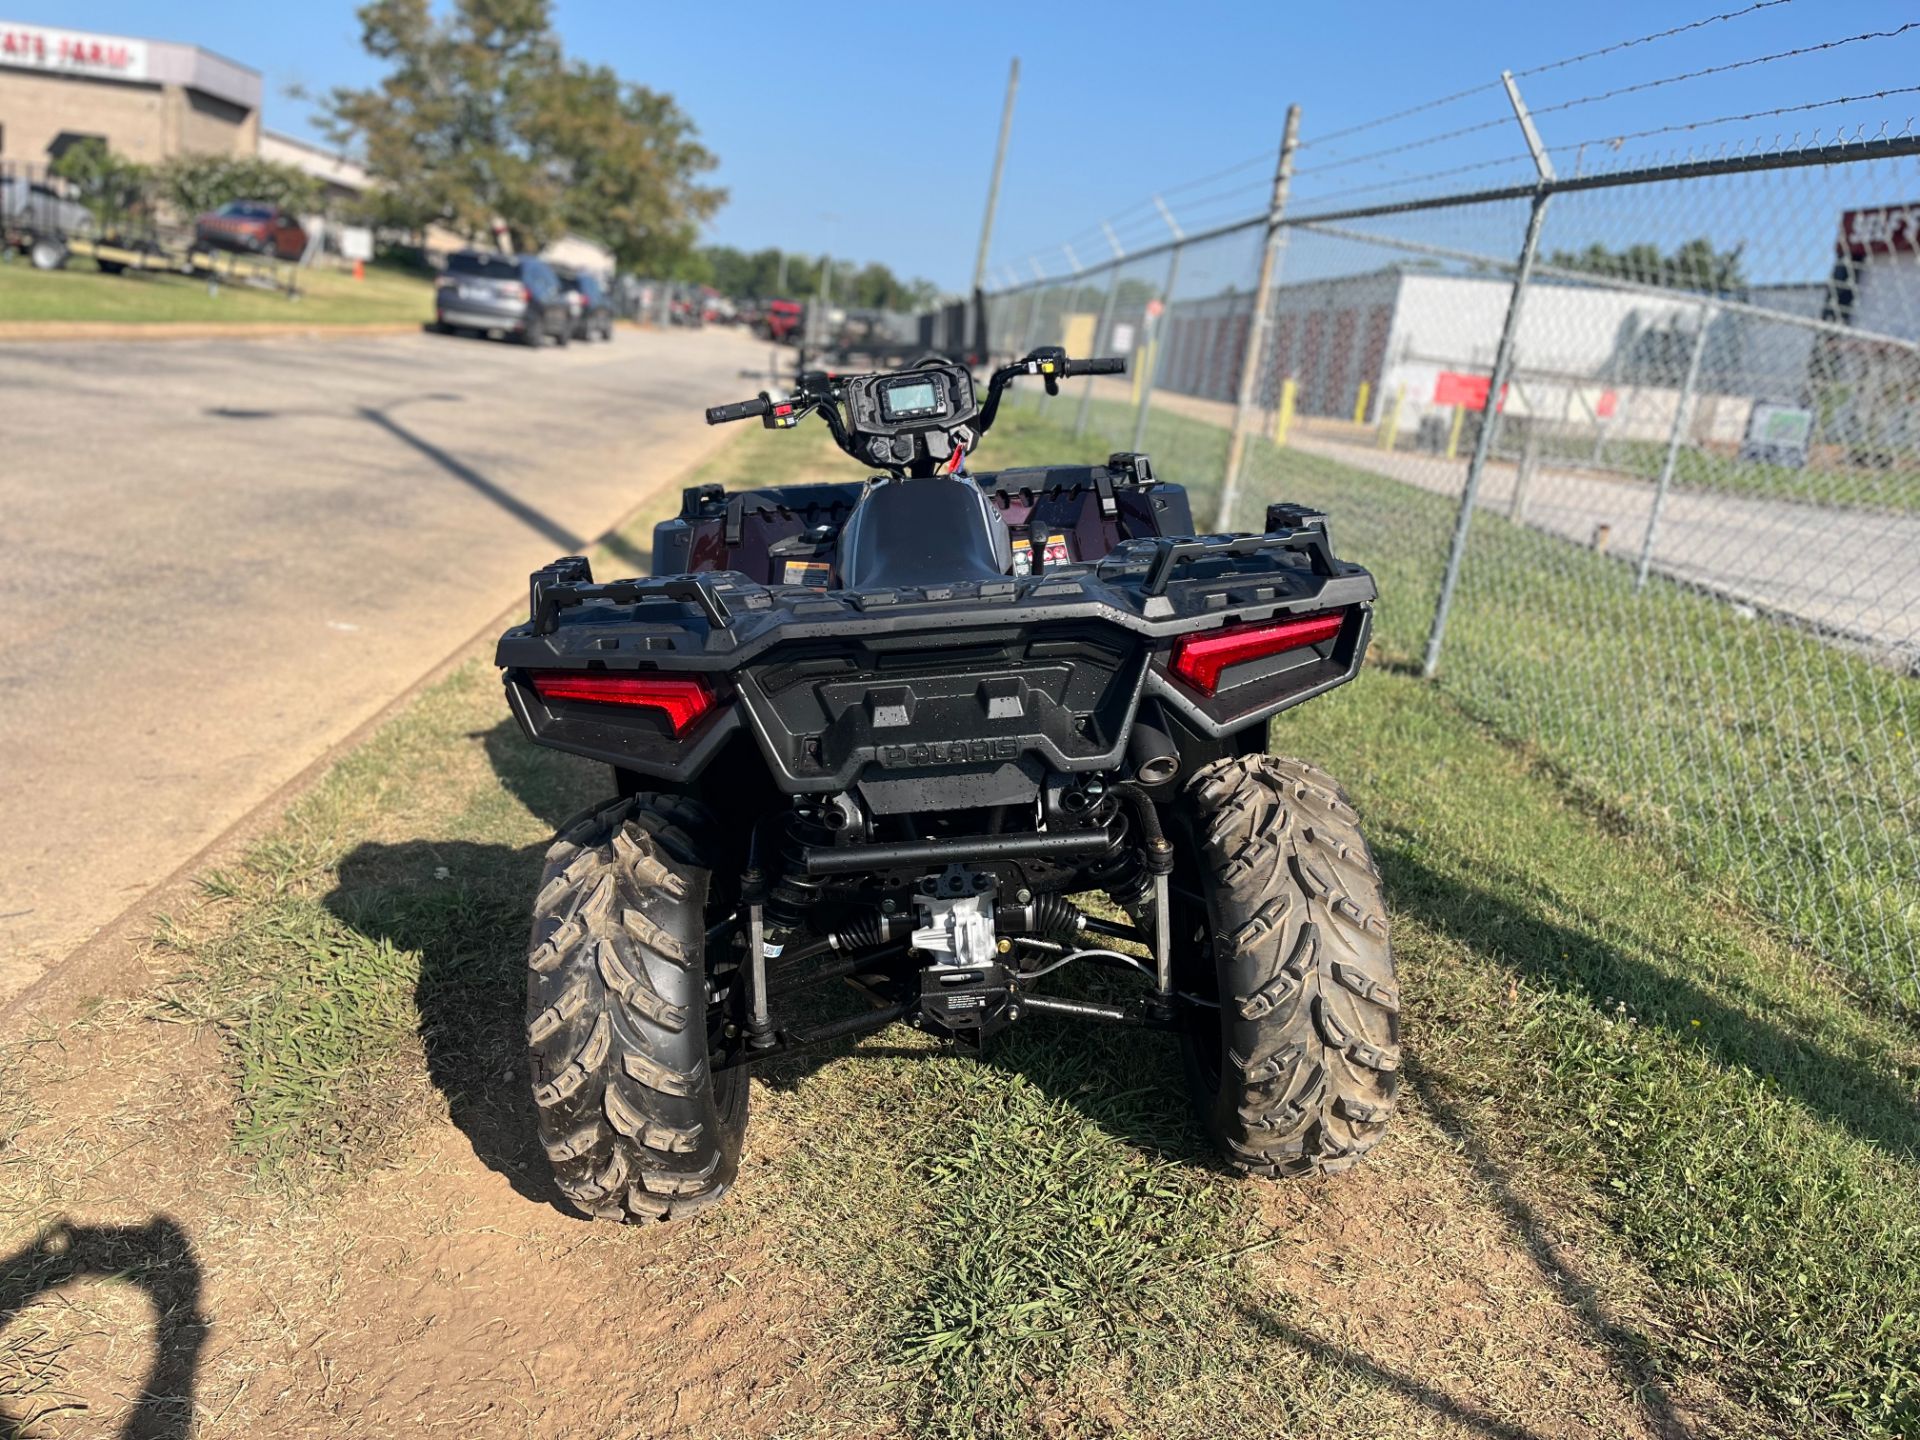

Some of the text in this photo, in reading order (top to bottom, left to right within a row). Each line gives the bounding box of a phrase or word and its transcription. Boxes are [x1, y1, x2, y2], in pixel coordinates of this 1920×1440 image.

[0, 31, 129, 68] ATE FARM
[884, 739, 1018, 766] POLARIS
